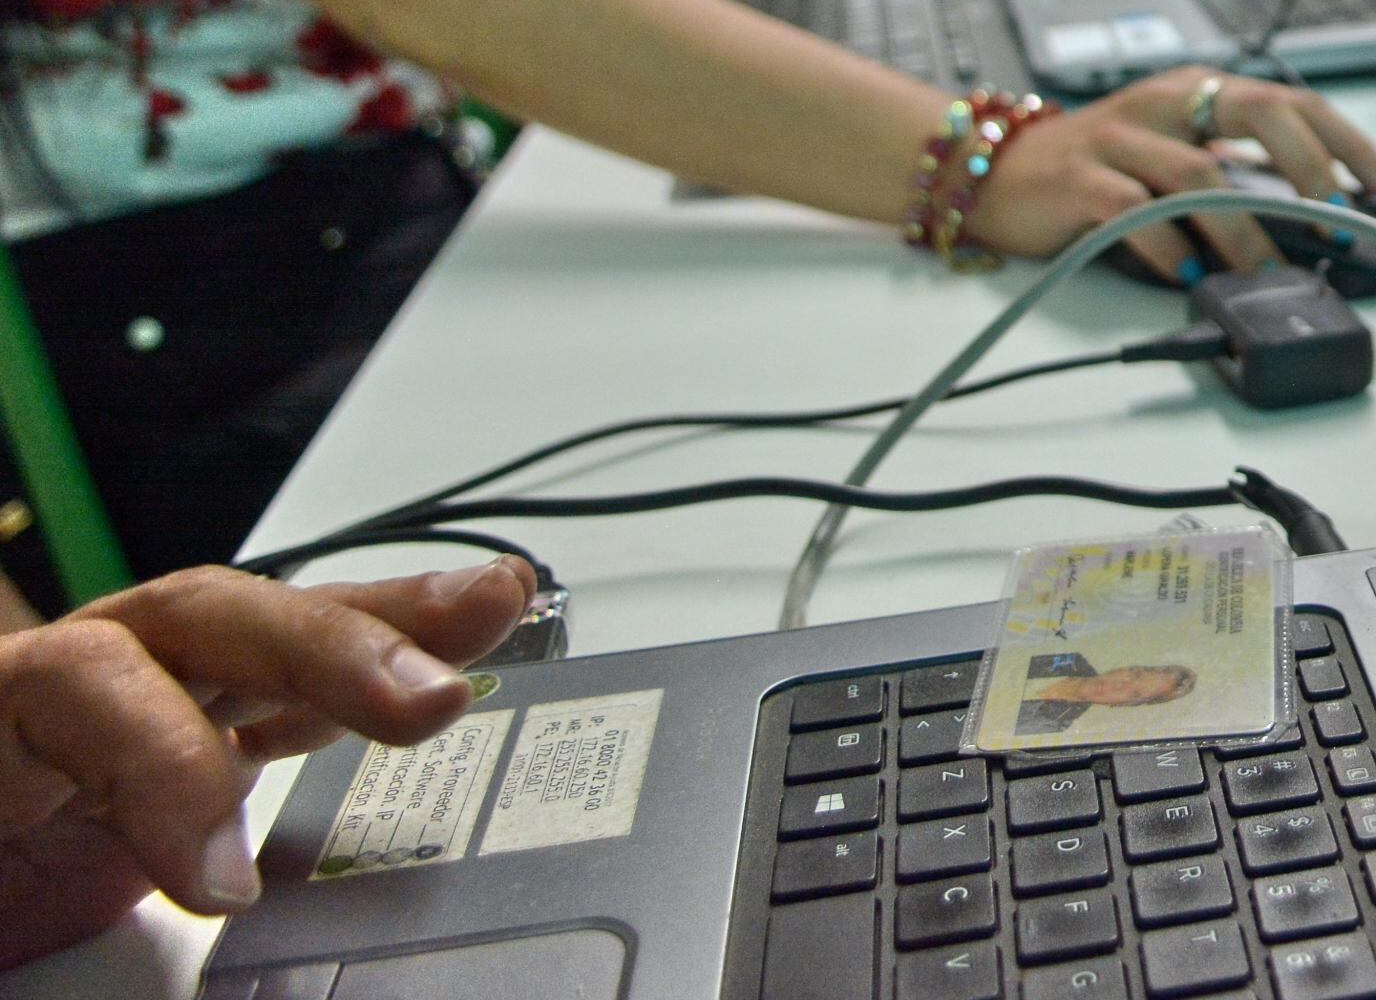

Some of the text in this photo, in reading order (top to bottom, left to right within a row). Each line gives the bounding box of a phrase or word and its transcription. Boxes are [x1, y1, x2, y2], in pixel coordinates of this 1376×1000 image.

[847, 684, 859, 699] ctrl
[588, 714, 605, 727] IP:
[602, 729, 618, 741] 01
[595, 743, 615, 766] 8000
[1155, 750, 1180, 767] W
[406, 731, 455, 809] Cert. Software
[1237, 766, 1258, 776] 3
[1273, 761, 1292, 771] #
[427, 727, 482, 824] Config. Proveedor
[591, 768, 609, 781] 42
[942, 768, 964, 782] Z
[341, 742, 397, 831] ertificación. Kit
[373, 744, 423, 821] rtificación. IP
[1051, 780, 1074, 792] S
[587, 783, 605, 796] 36
[1166, 806, 1189, 819] E
[1288, 816, 1310, 828] $
[943, 824, 966, 839] X
[1253, 824, 1274, 837] 4
[836, 843, 849, 857] alt
[1057, 838, 1080, 851] D
[1178, 866, 1201, 881] R
[1268, 884, 1294, 896] 5
[1308, 876, 1330, 894] %
[944, 886, 968, 902] C
[1064, 900, 1088, 912] F
[1191, 930, 1217, 943] T
[946, 953, 970, 968] V
[1287, 953, 1313, 966] 6
[1072, 971, 1097, 989] G
